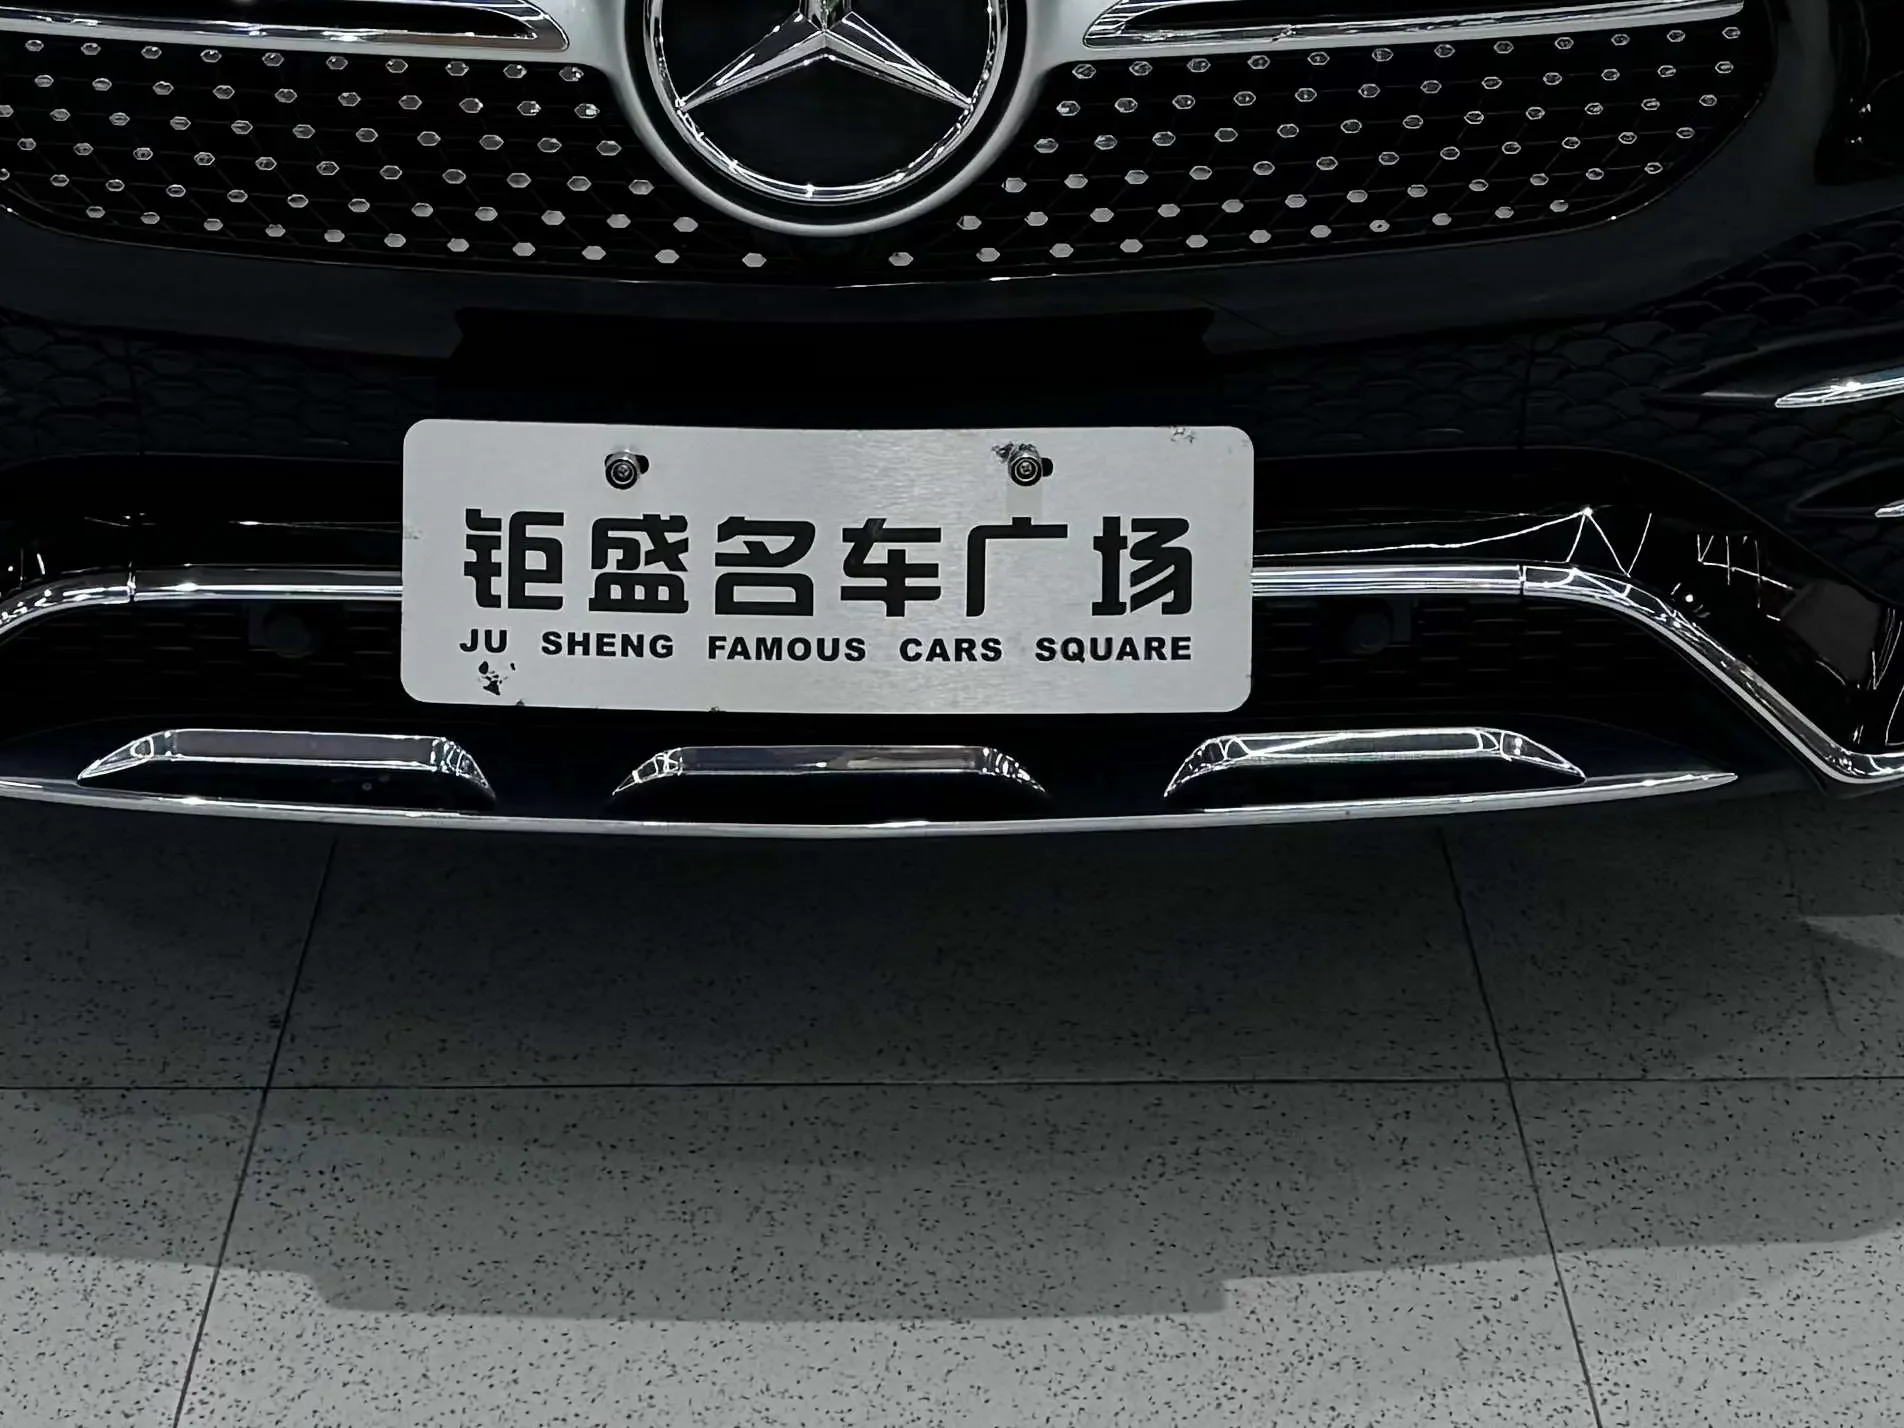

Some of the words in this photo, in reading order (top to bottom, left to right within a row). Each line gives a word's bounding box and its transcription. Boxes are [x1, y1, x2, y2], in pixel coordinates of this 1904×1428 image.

[463, 509, 1192, 616] 钜盛名车广场
[460, 630, 508, 654] JU
[541, 631, 674, 659] SHENG
[707, 637, 867, 662] FAMOUS
[899, 637, 1002, 663] CARS
[1034, 637, 1192, 662] SQUARE
